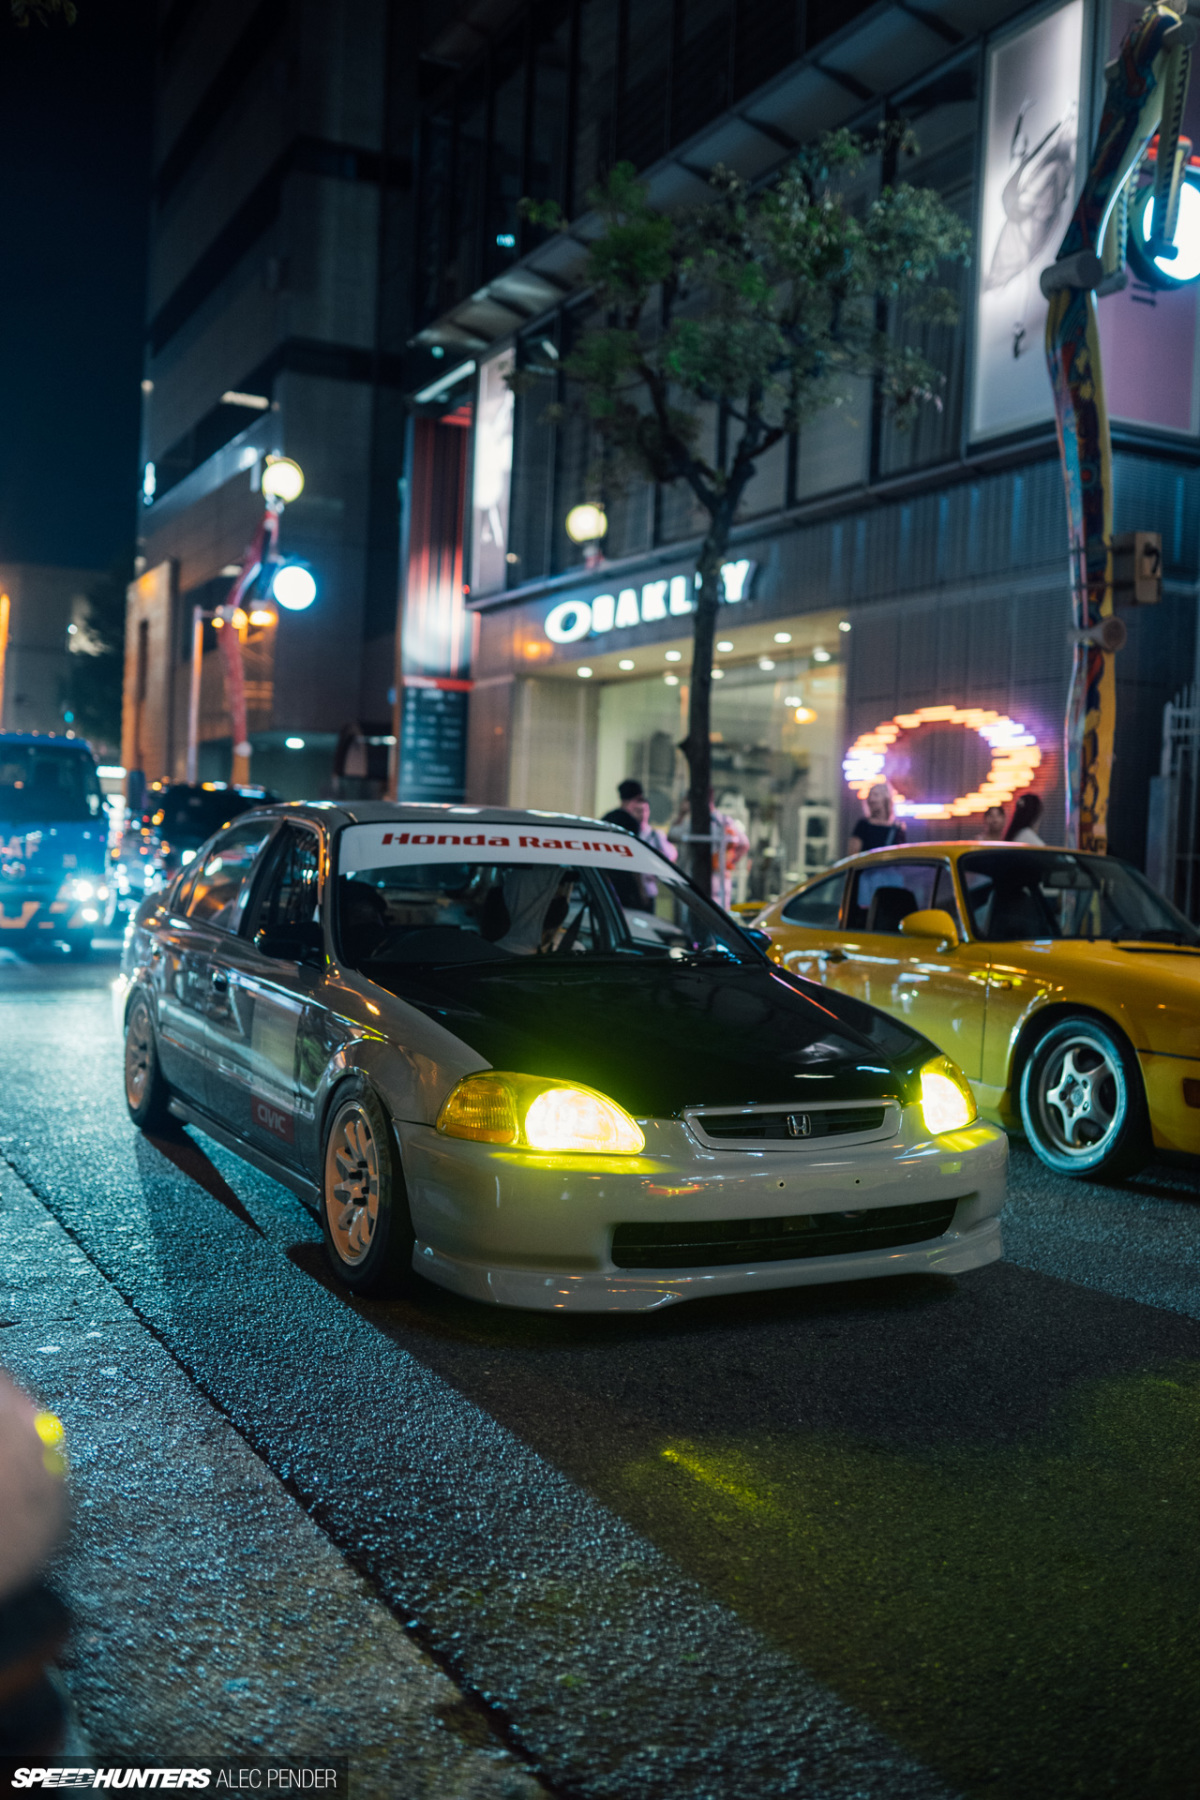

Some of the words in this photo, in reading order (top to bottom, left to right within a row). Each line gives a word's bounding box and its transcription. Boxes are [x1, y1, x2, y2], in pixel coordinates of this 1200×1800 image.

[381, 832, 510, 847] Honda
[518, 836, 634, 857] Racing
[256, 1103, 287, 1134] CIVIC
